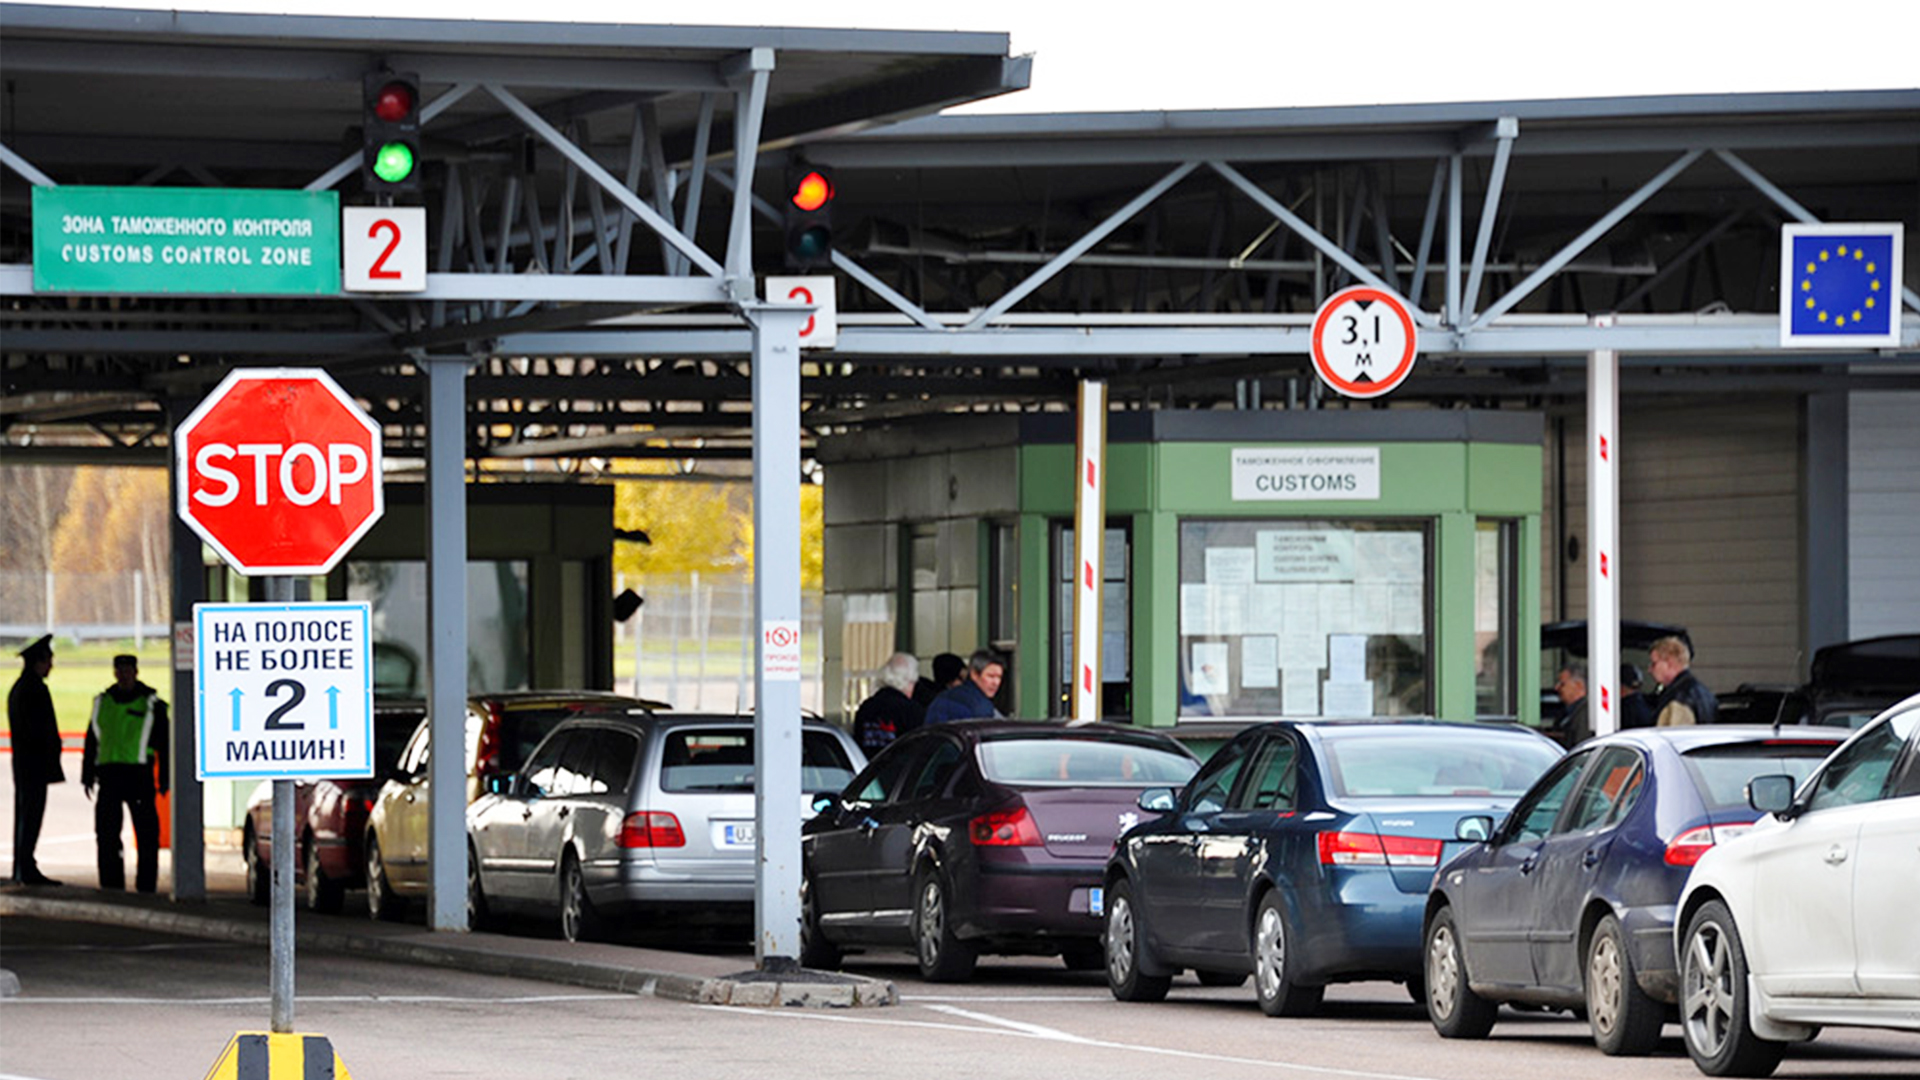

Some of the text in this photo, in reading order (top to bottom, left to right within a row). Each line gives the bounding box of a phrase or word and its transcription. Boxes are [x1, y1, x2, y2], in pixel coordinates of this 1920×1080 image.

[62, 215, 312, 237] ЗОНА ТАМОЖЕННОГО КОНТРОЛЯ
[62, 244, 312, 265] CUSTOMS CONTROL ZONE
[368, 218, 402, 280] 2
[1341, 315, 1380, 348] 3,1
[193, 442, 368, 507] STOP
[1256, 474, 1357, 492] CUSTOMS
[214, 620, 353, 643] НА ПОЛОСЕ
[215, 650, 250, 671] НЕ
[261, 648, 354, 670] БОЛЕЕ
[264, 678, 306, 731] 2
[226, 739, 345, 762] МАШИН!
